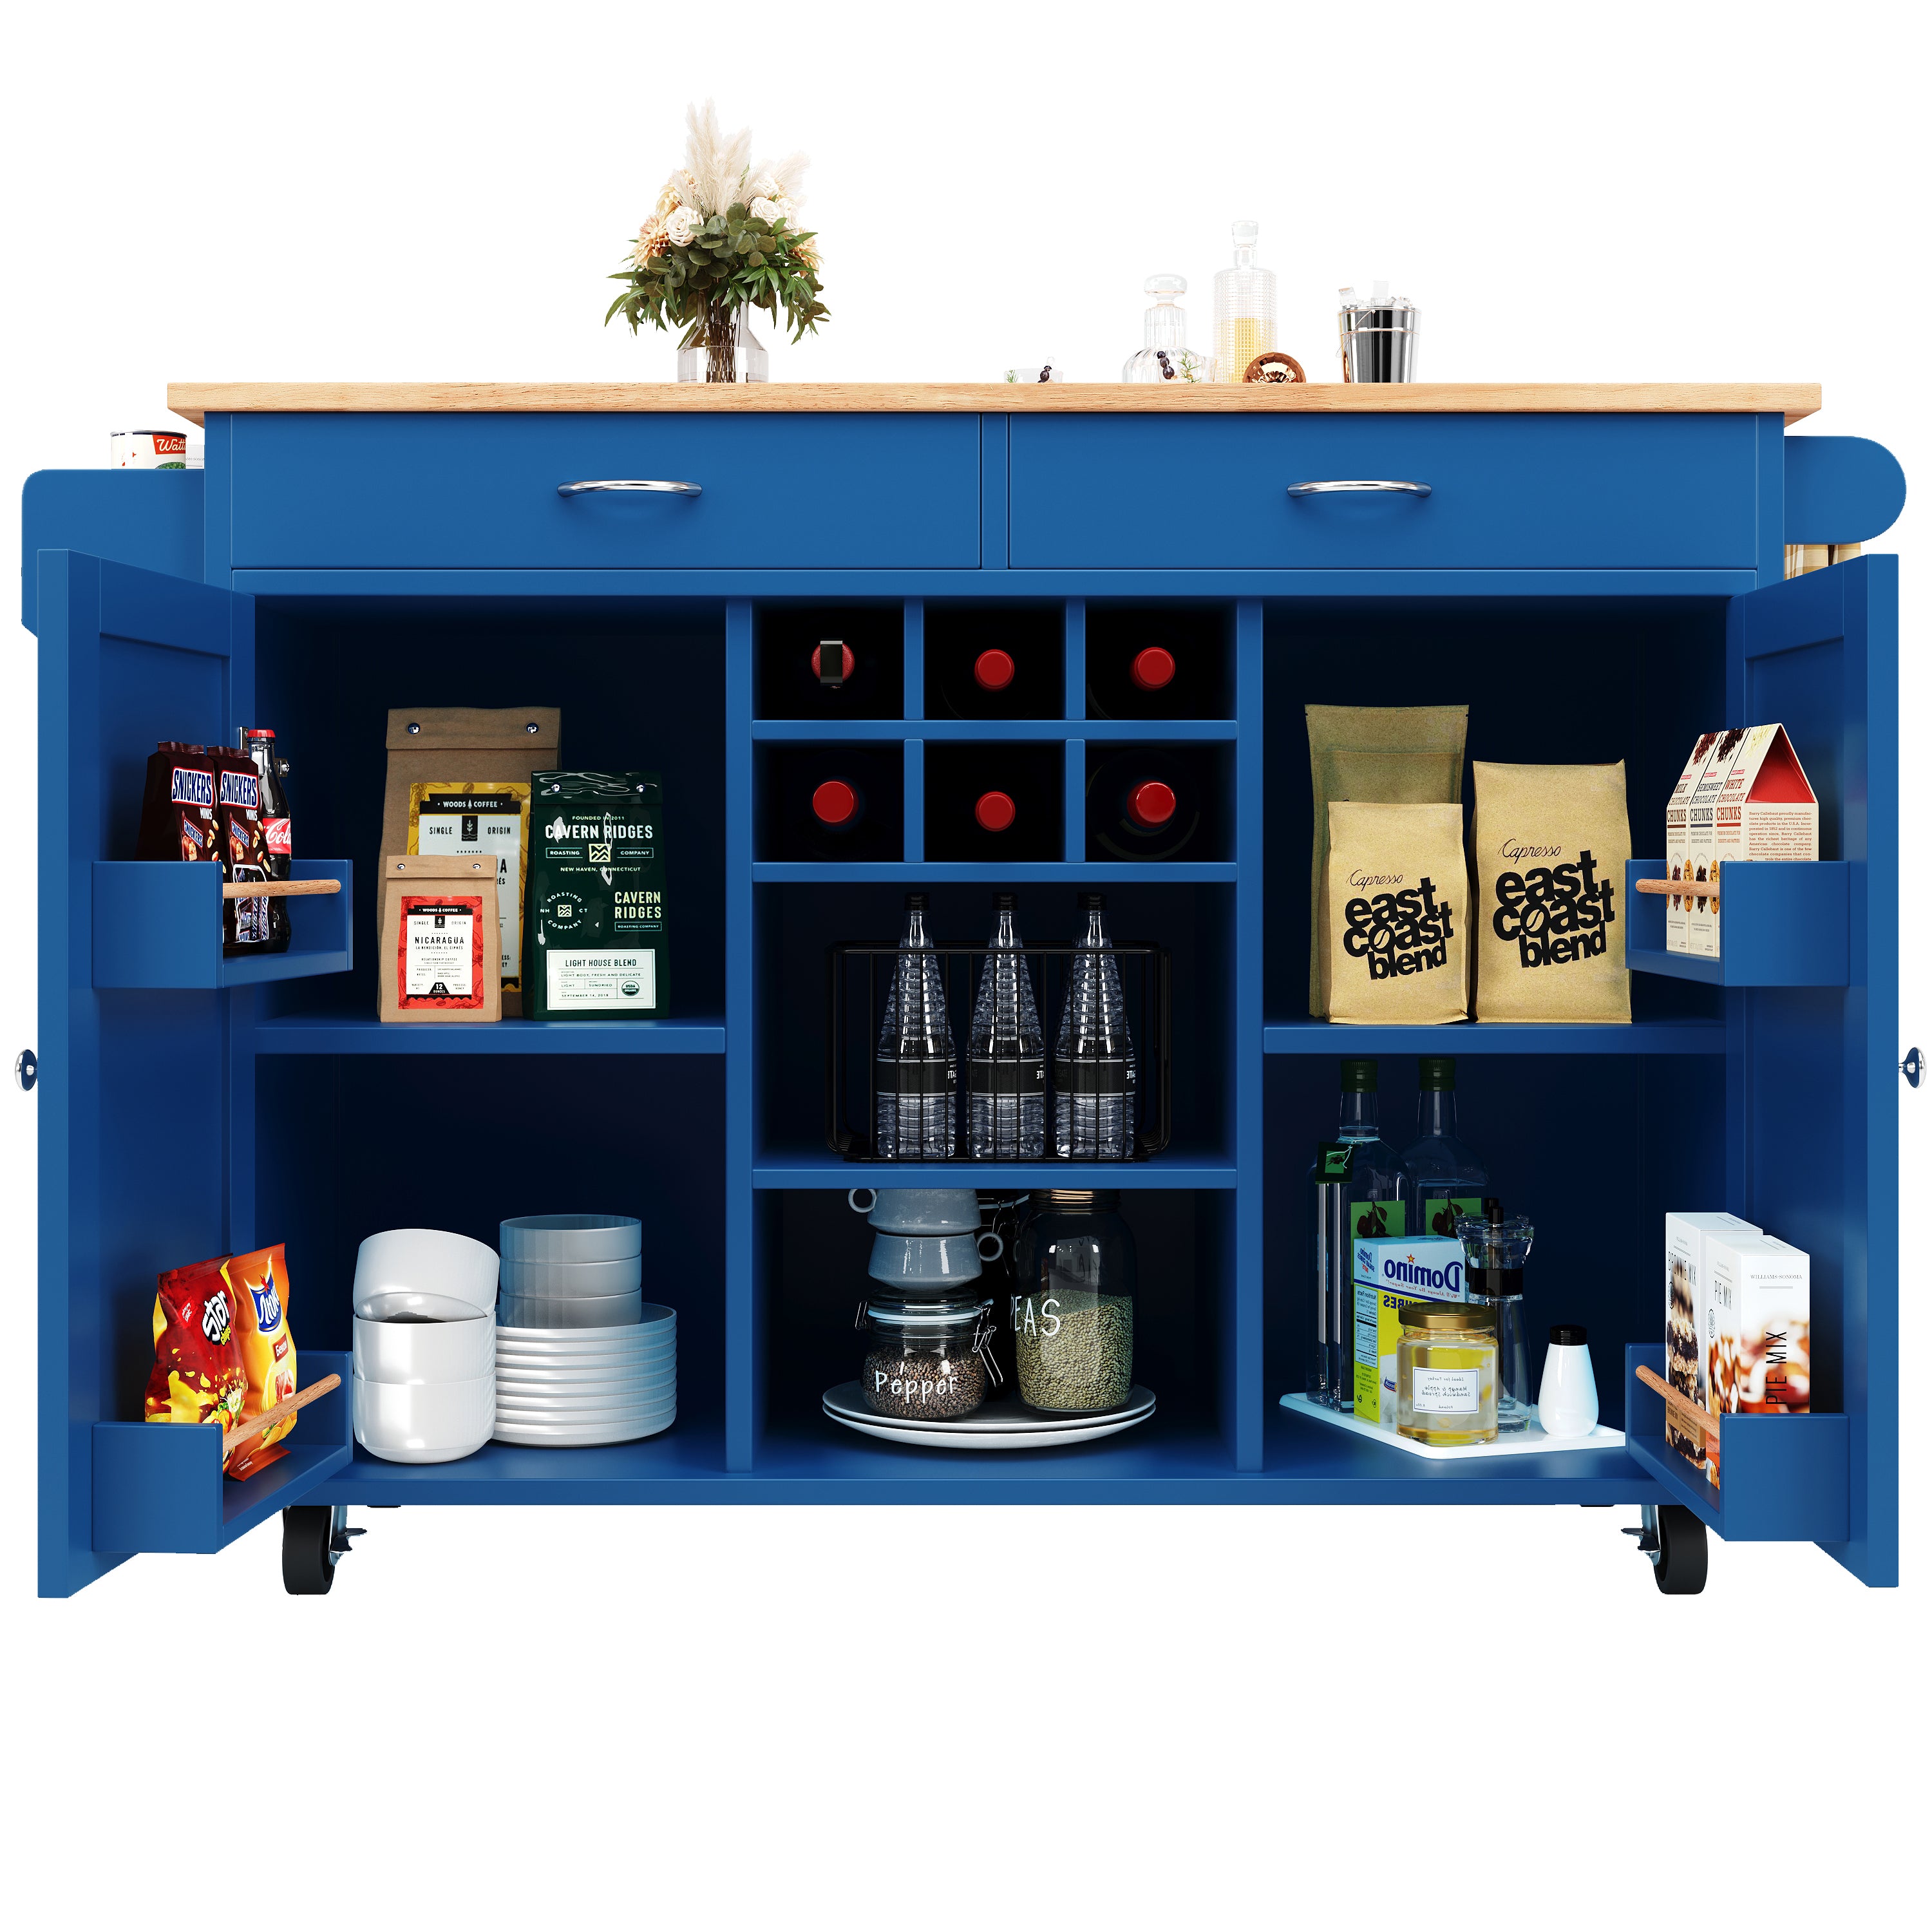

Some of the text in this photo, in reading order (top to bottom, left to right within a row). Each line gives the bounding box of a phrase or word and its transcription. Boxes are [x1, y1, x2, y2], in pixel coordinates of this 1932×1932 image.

[173, 770, 212, 804] SNICKERS
[221, 773, 257, 806] SNICKERS
[1674, 784, 1688, 793] MILK
[1698, 782, 1723, 791] SEMISWEET
[1725, 779, 1745, 790] WHITE
[1692, 795, 1717, 804] CHOCOLATE
[1718, 793, 1745, 802] CHOCOLATE
[200, 808, 213, 820] MINIS
[246, 810, 257, 821] MINIS
[1667, 809, 1686, 822] CHUNKS
[1690, 808, 1712, 821] CHUNKS
[1717, 806, 1741, 820] CHUNKS
[185, 821, 202, 847] SNICKERS
[545, 825, 653, 839] CAVERN RIDGES
[1497, 838, 1561, 864] Capresso
[1346, 869, 1403, 891] Capresso
[1495, 851, 1598, 907] east
[547, 892, 582, 902] ROASTING
[615, 892, 661, 904] CAVERN
[1345, 877, 1440, 928] east
[615, 907, 661, 918] RIDGES
[1493, 880, 1615, 941] coast
[548, 920, 582, 929] COMPANY
[1343, 902, 1454, 958] coast
[1519, 920, 1606, 968] blend
[1368, 937, 1446, 980] blend
[1668, 1251, 1687, 1280] BROWNIE
[202, 1291, 230, 1341] Star
[221, 1325, 231, 1345] chips
[1766, 1332, 1787, 1405] PIE MIX
[875, 1370, 958, 1403] Pepper
